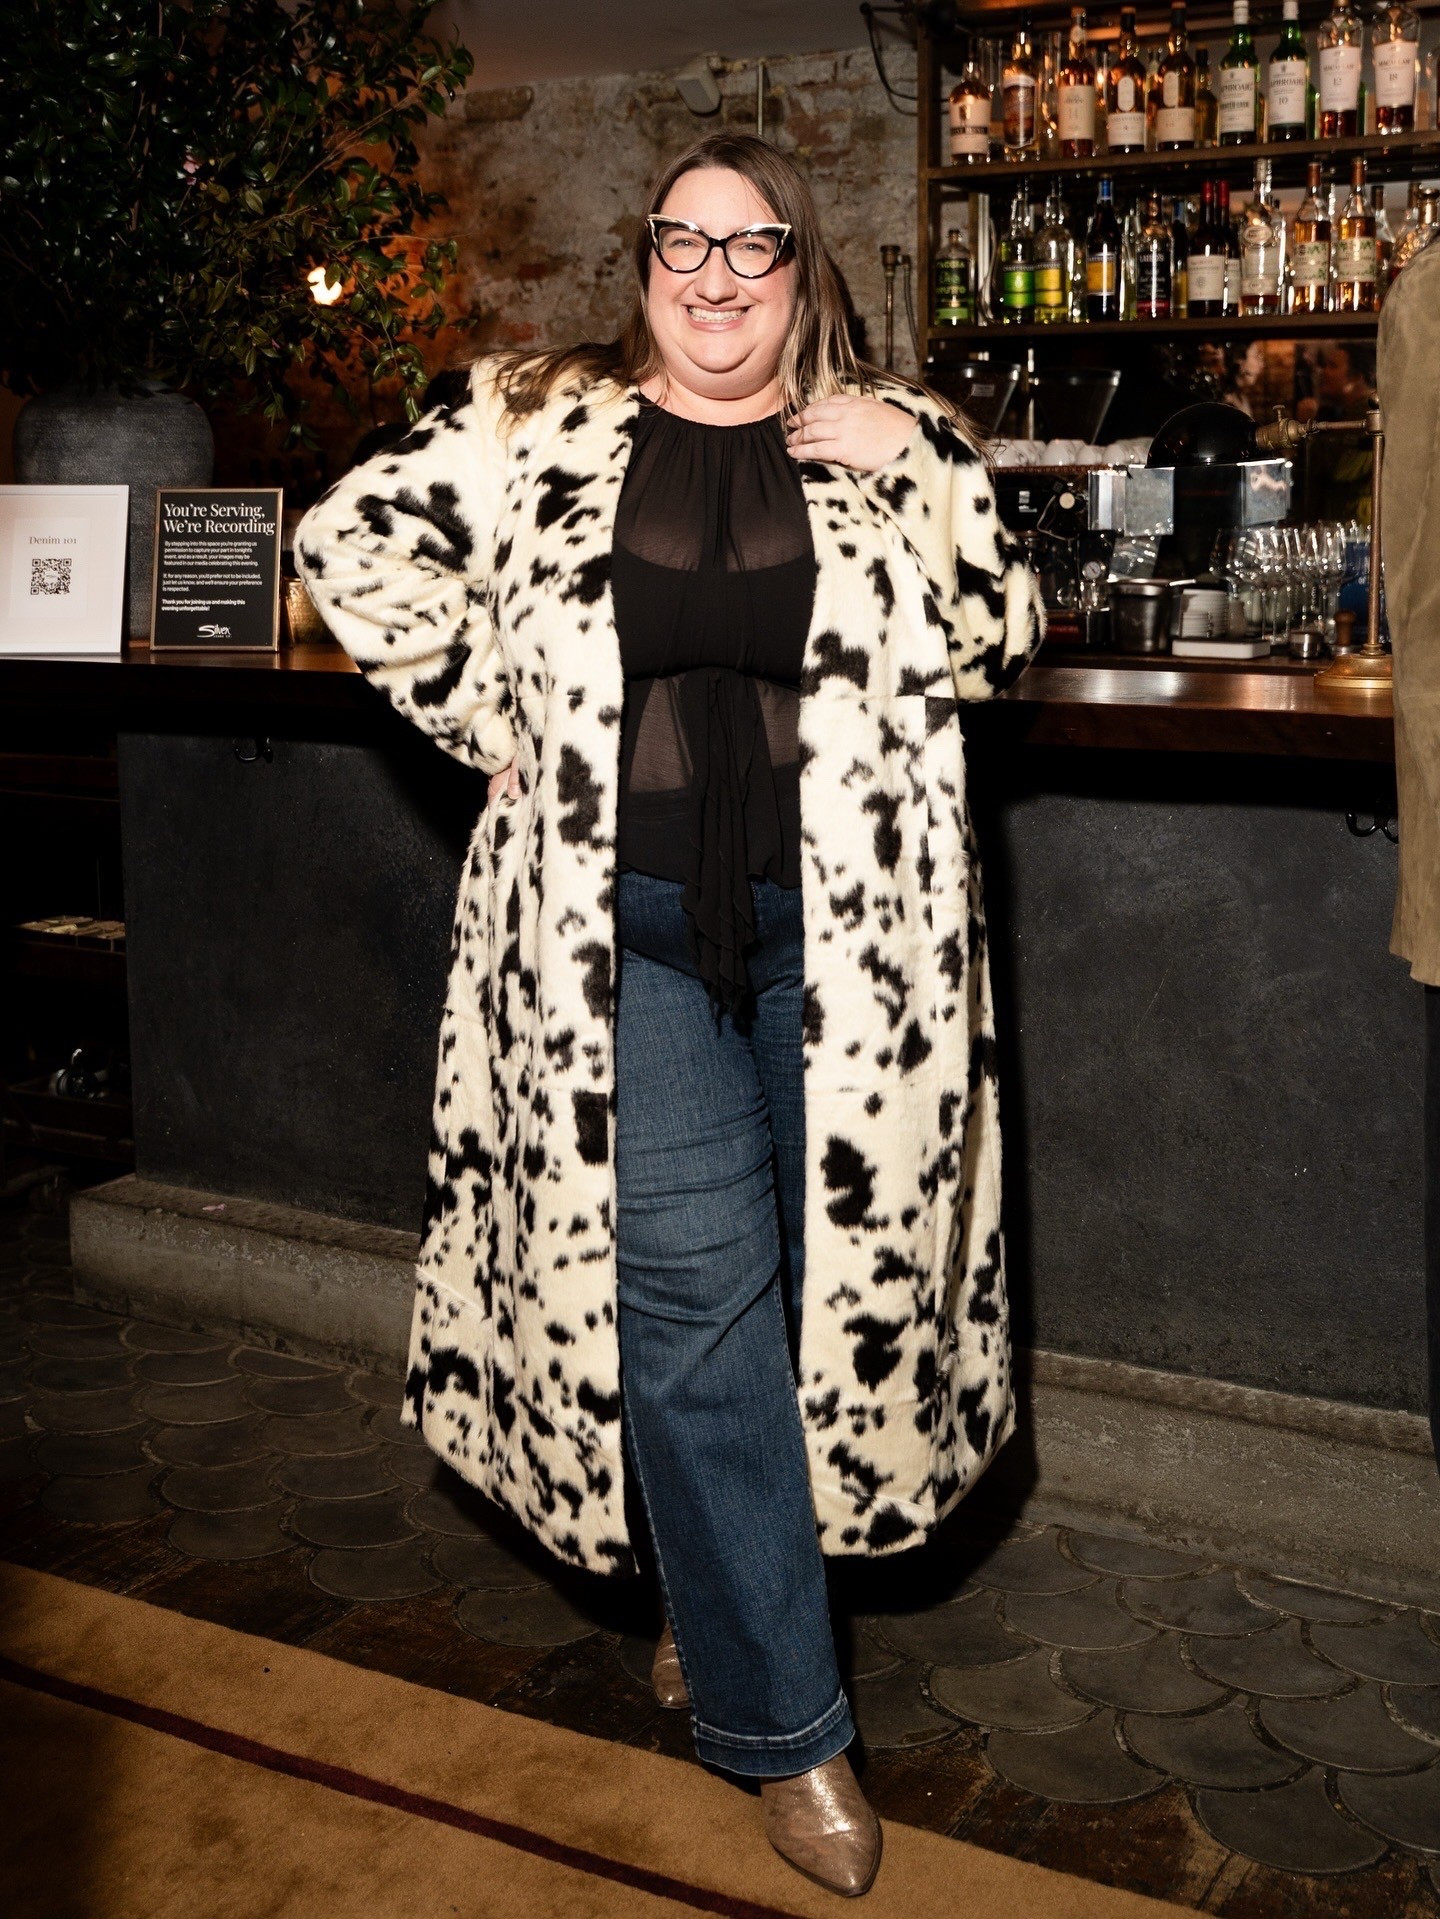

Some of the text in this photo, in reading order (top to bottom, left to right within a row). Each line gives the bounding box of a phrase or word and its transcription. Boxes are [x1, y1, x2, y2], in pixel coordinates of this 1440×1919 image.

[1278, 97, 1288, 105] 10
[164, 503, 265, 520] You’re Serving,
[163, 519, 276, 536] We’re Recording
[29, 536, 61, 545] Denim
